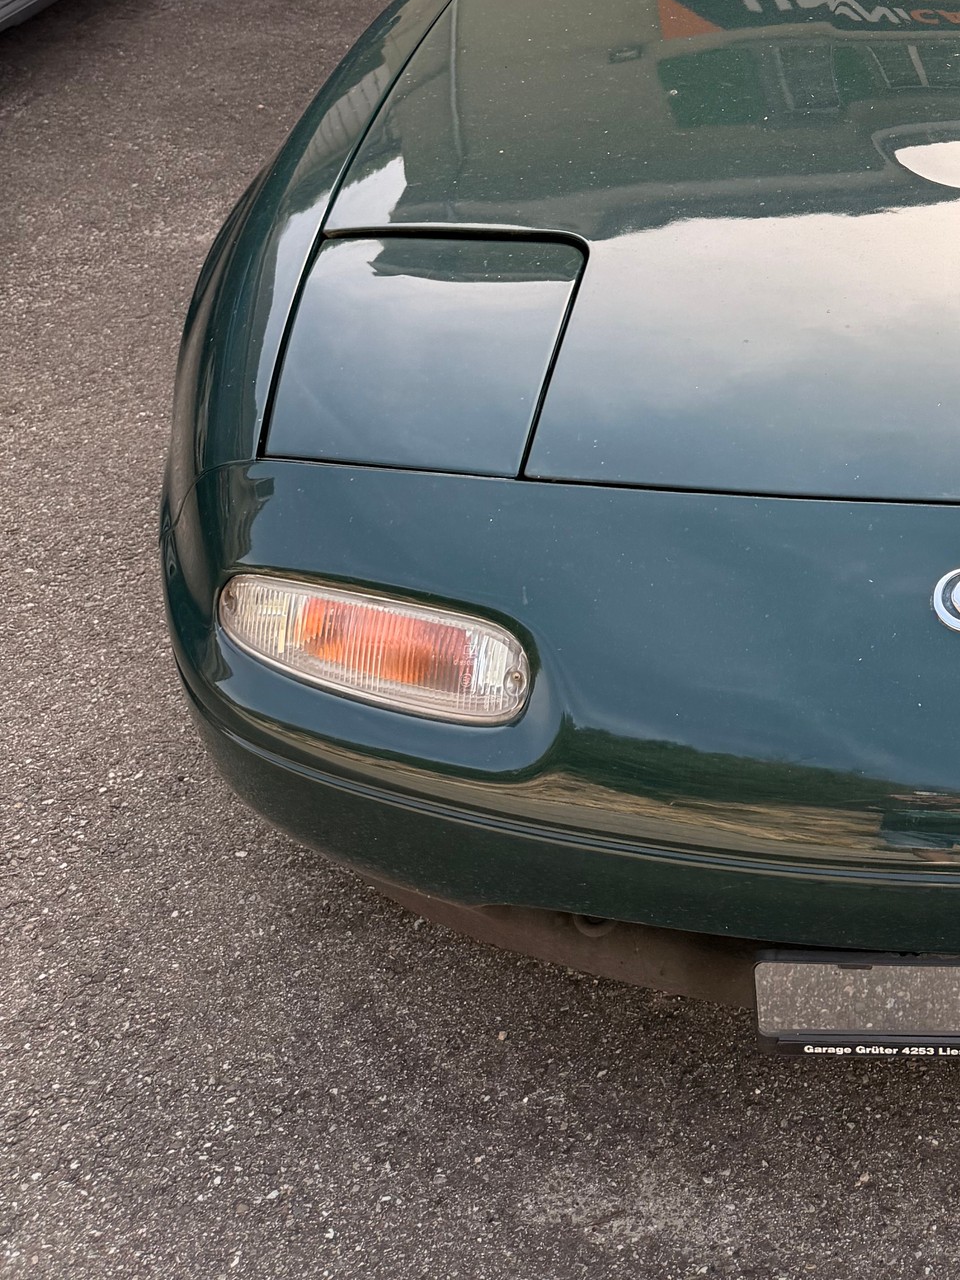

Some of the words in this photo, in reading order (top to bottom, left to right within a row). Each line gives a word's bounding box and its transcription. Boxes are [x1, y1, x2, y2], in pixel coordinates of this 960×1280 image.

[804, 1045, 852, 1055] Garage
[855, 1045, 898, 1055] Grüter
[902, 1047, 935, 1055] 4253
